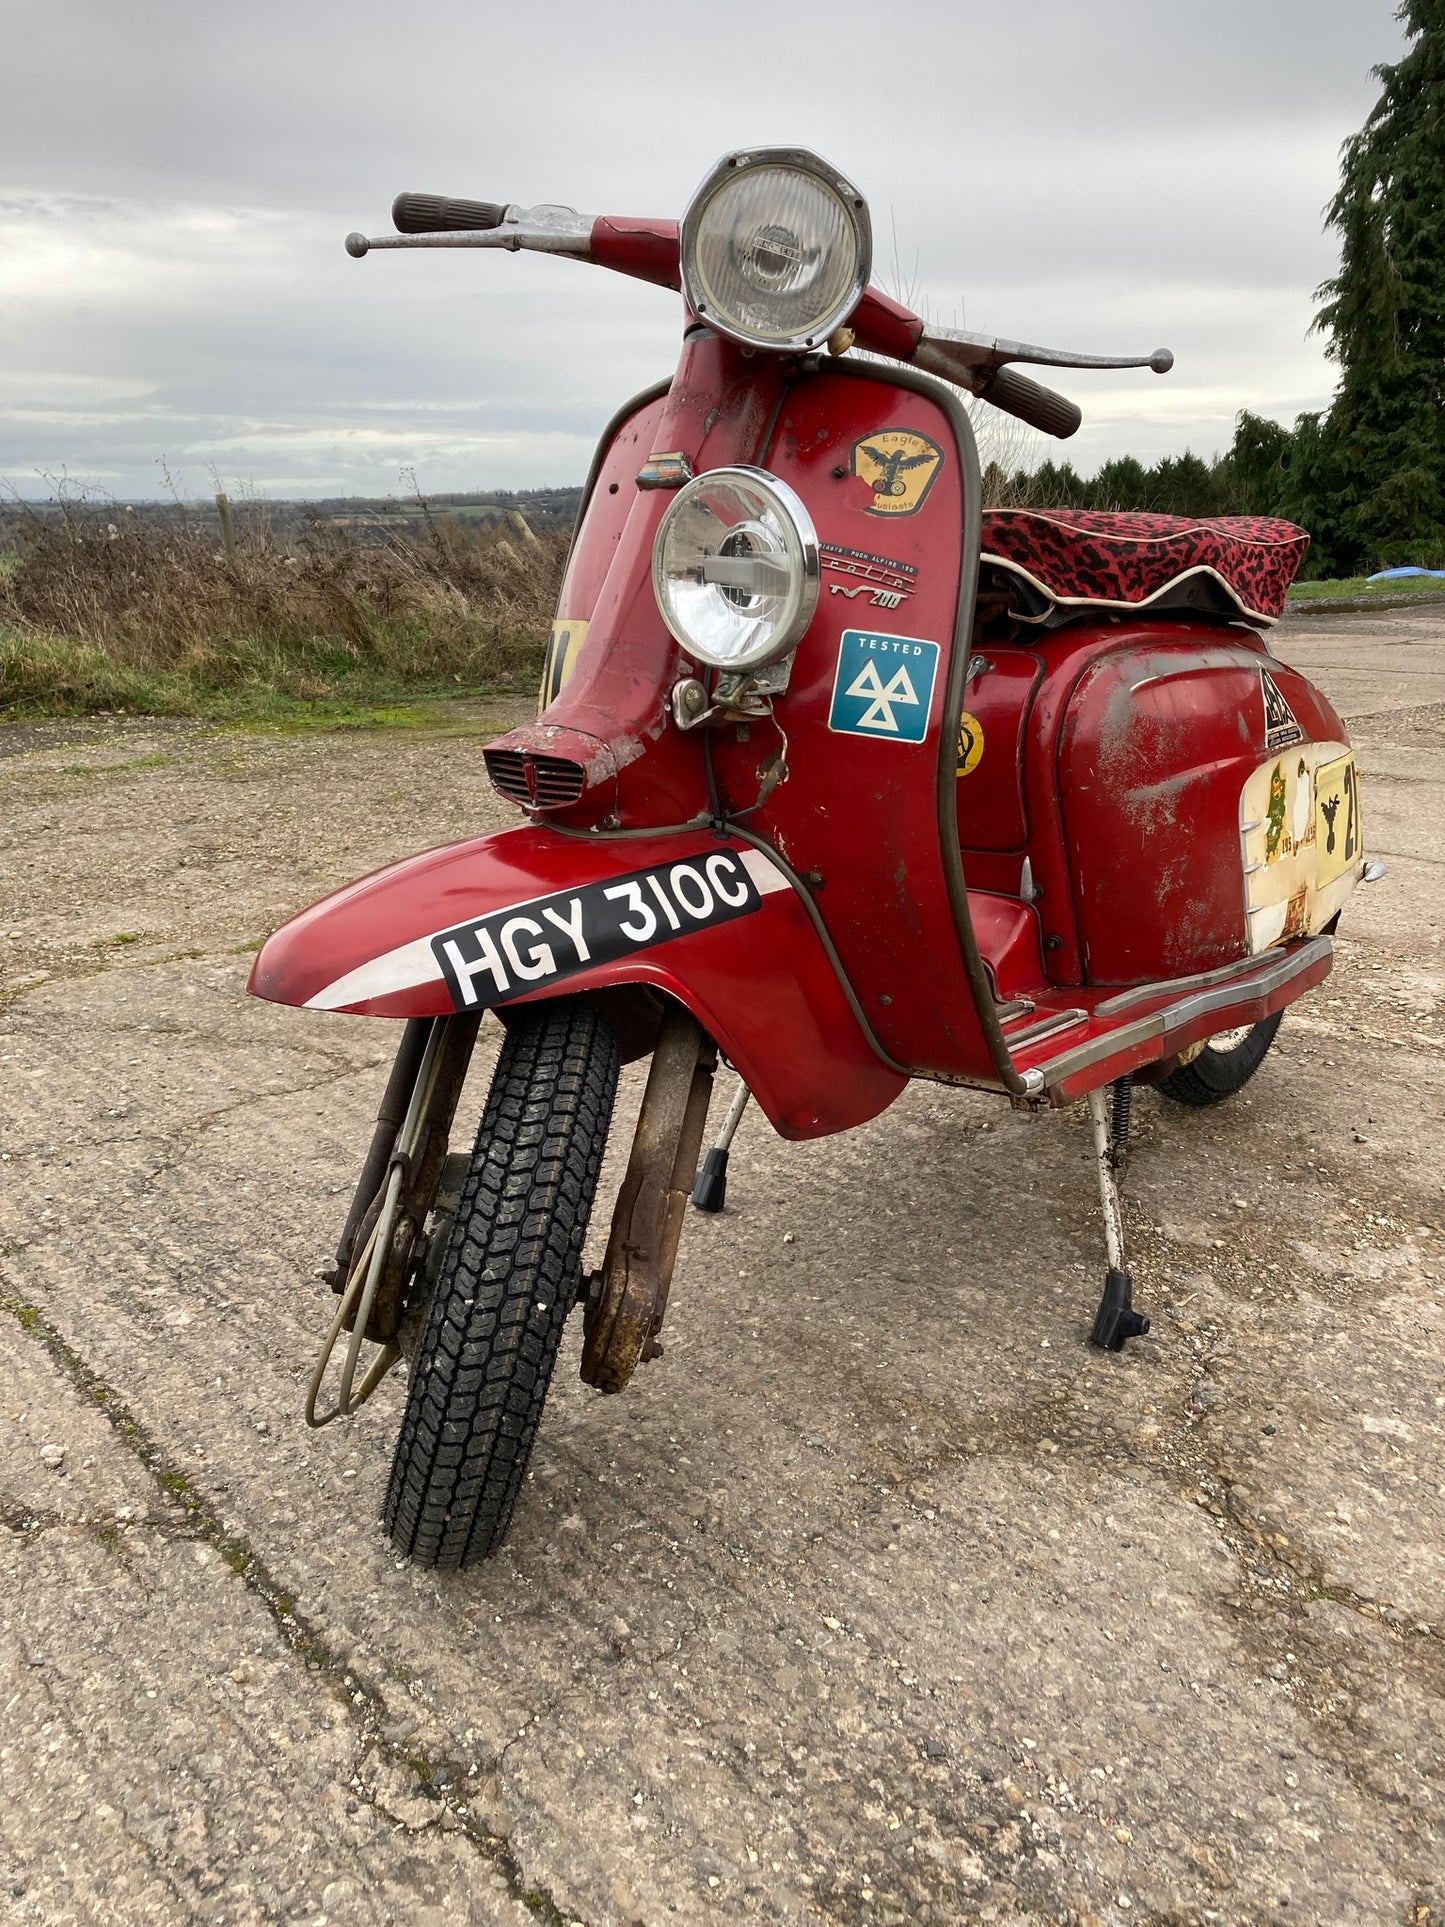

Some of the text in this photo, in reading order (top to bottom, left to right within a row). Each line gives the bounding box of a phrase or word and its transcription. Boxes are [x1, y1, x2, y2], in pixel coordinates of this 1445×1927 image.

[882, 434, 919, 447] Eagle
[850, 551, 868, 560] PUCH
[872, 556, 897, 568] ALPINE
[869, 589, 905, 609] 200
[858, 637, 922, 656] TESTED
[442, 854, 749, 1007] HGY 310C
